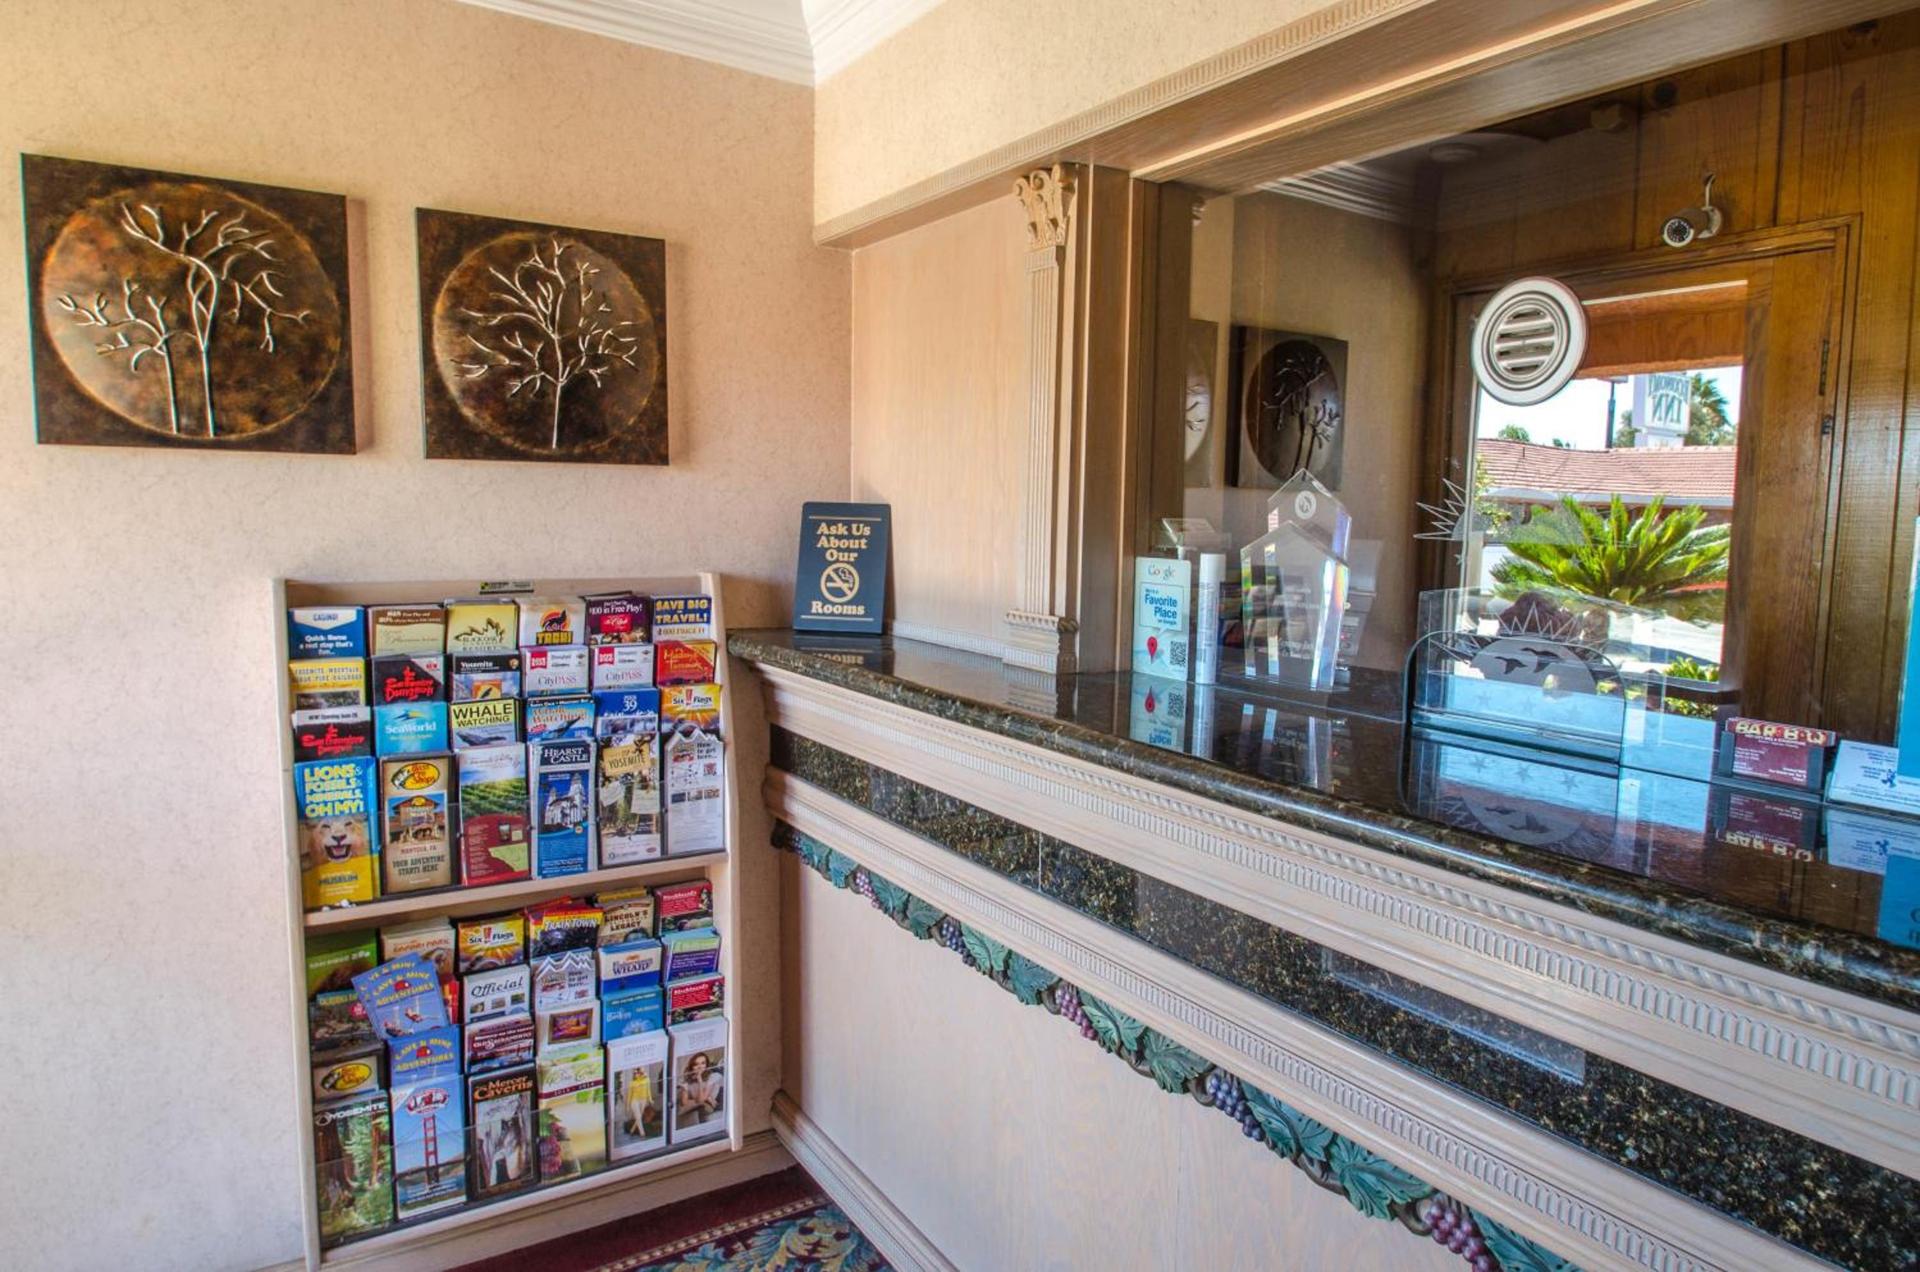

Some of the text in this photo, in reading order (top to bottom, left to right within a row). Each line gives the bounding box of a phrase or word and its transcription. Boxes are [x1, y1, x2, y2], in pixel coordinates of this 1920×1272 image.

[817, 522, 871, 535] Ask Us
[817, 536, 867, 548] About
[825, 549, 858, 561] Our
[655, 600, 708, 611] SAVE BIG
[1145, 594, 1177, 607] Favorite
[811, 601, 865, 615] Rooms
[1154, 606, 1177, 619] Place
[656, 613, 708, 623] TRAVEL!
[623, 700, 637, 711] 39
[694, 696, 712, 704] Flags
[453, 703, 512, 719] WHALE
[385, 721, 436, 734] SeaWorld
[457, 715, 510, 727] WATCHING
[544, 748, 584, 757] HEARST
[550, 754, 588, 763] CASTLE
[304, 764, 356, 782] LIONS
[305, 802, 332, 817] OH
[493, 932, 514, 941] Flags
[471, 976, 523, 997] Official
[474, 1080, 533, 1099] Caverns
[330, 1102, 386, 1119] YOSEMITE
